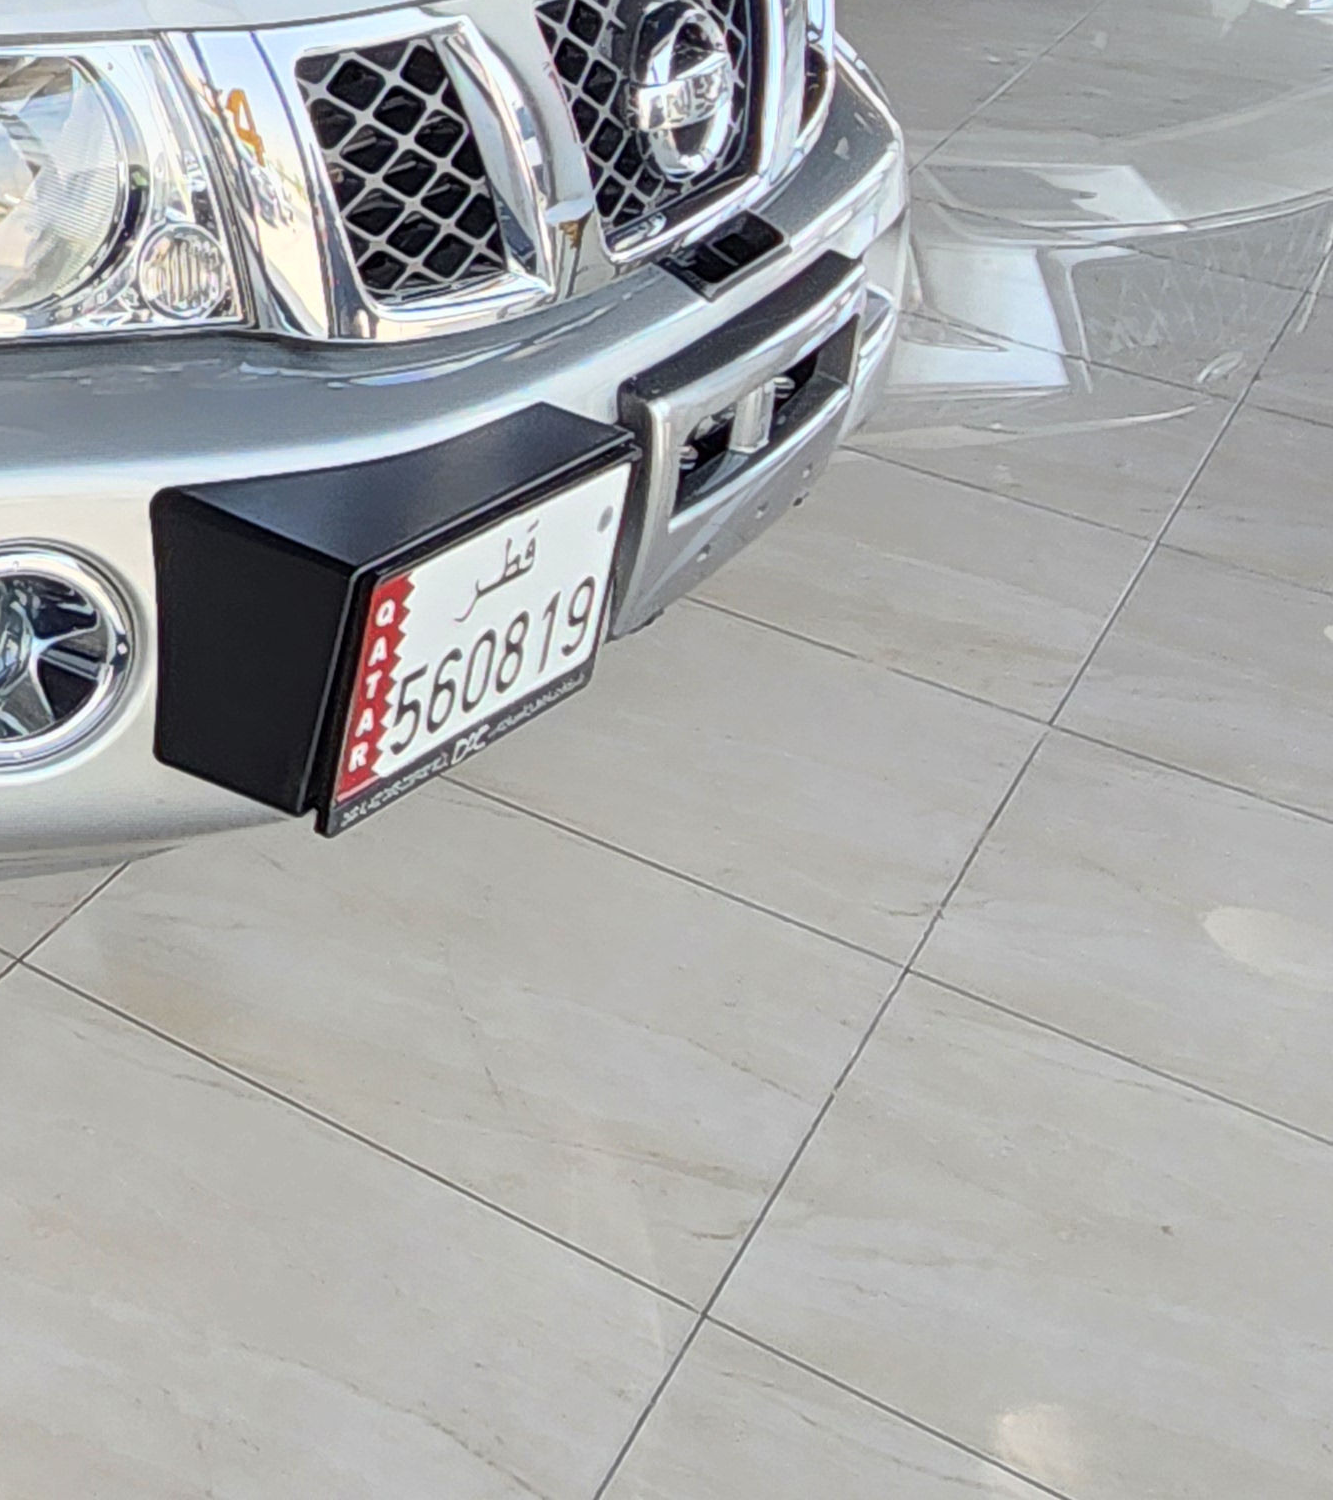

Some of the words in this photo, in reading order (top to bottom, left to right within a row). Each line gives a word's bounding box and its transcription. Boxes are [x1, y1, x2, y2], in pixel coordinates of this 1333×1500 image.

[454, 520, 541, 623] قطر
[348, 599, 395, 769] QATAR
[390, 575, 597, 757] 560819
